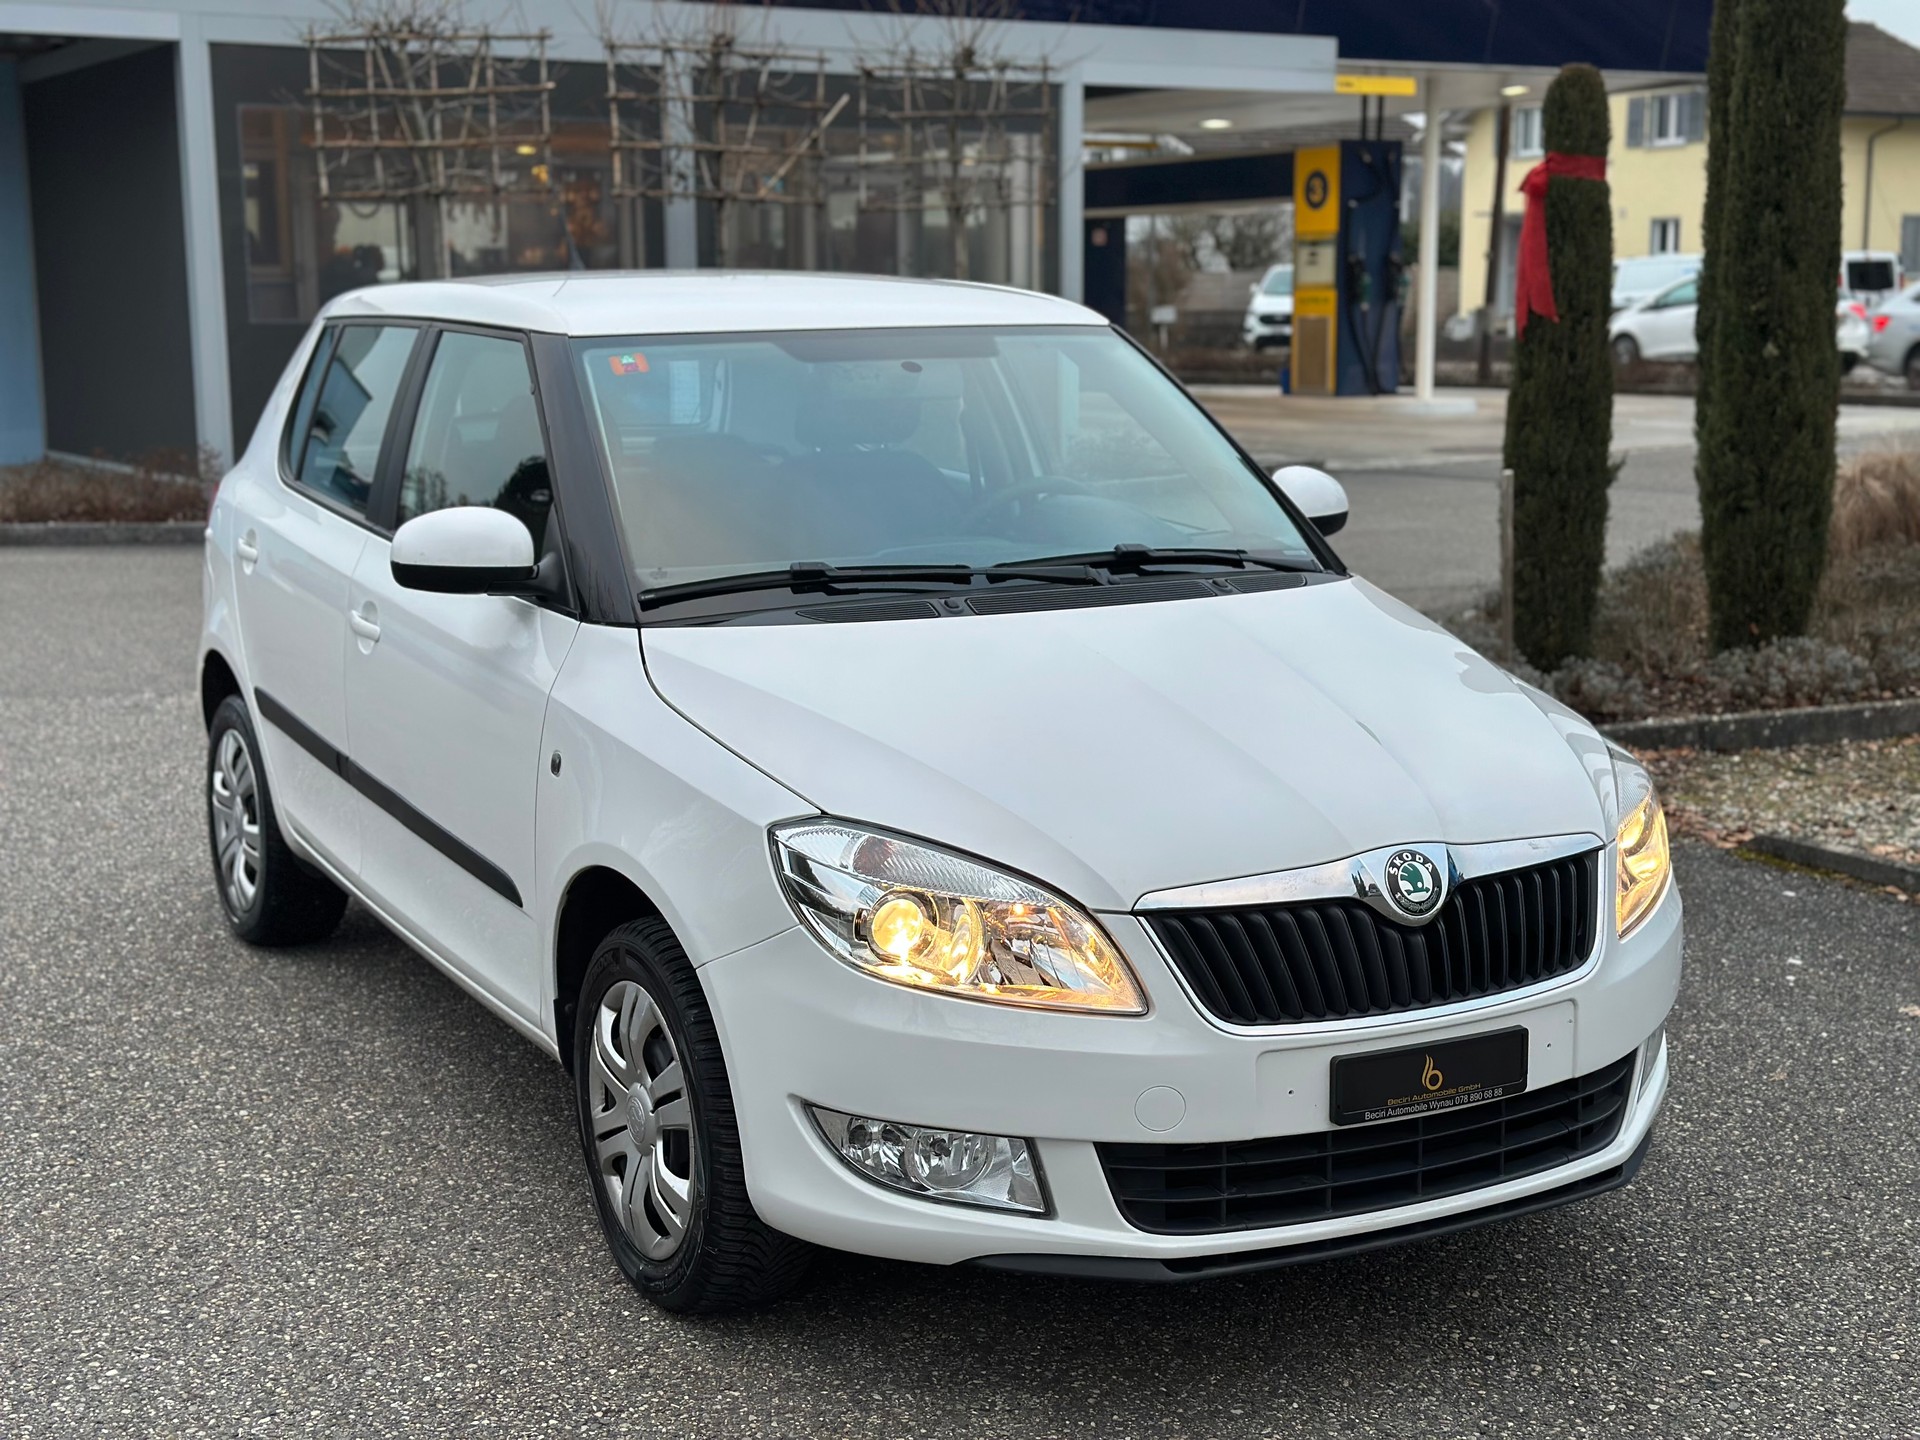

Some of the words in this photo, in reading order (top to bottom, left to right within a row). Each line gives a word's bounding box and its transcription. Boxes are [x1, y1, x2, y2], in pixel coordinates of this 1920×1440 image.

[1364, 1109, 1386, 1120] Beciri
[1386, 1103, 1428, 1116] Automobile
[1429, 1099, 1454, 1111] Wynau
[1455, 1095, 1469, 1105] 078
[1469, 1092, 1483, 1102] 890
[1483, 1089, 1493, 1099] 68
[1412, 1087, 1457, 1102] Automobile
[1458, 1083, 1481, 1093] GmbH
